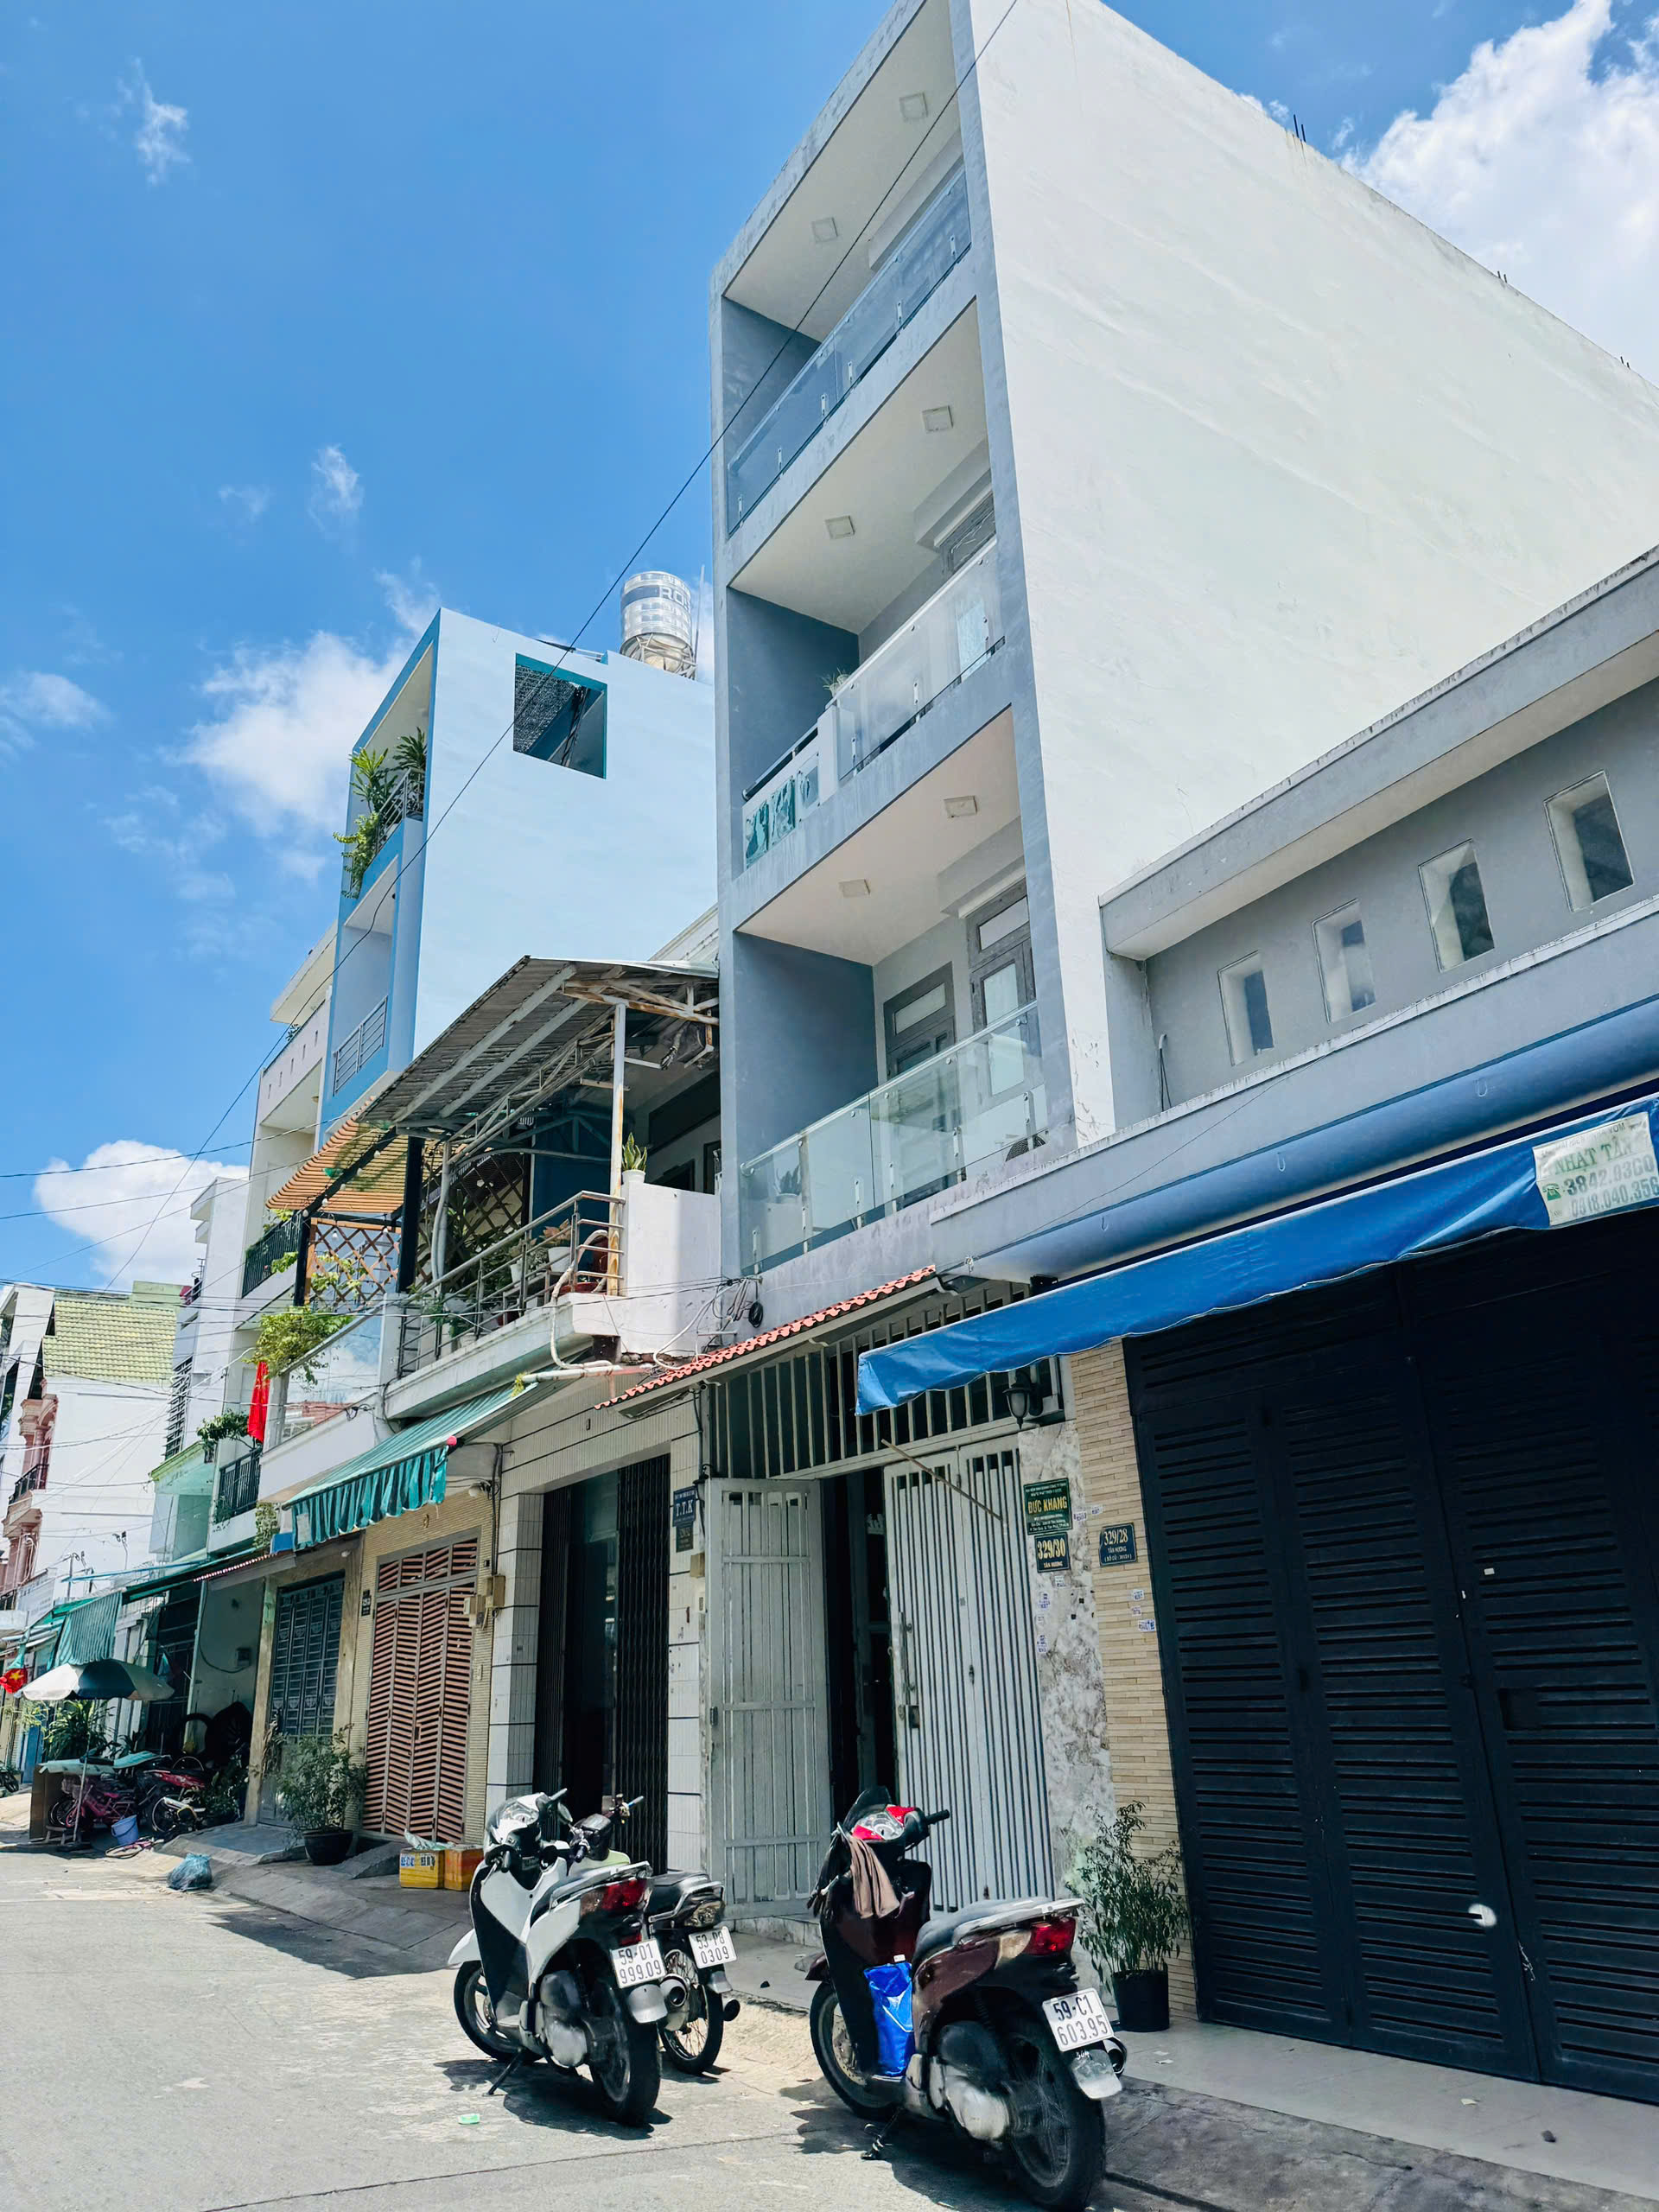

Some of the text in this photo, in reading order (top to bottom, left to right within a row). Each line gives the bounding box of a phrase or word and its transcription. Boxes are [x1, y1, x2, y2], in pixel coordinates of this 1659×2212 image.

[1043, 1496, 1068, 1512] KHANG
[1103, 1529, 1128, 1546] 329/28
[1037, 1538, 1065, 1560] 329/30
[700, 1946, 729, 1964] 0309
[620, 1960, 662, 1984] 999.09
[1057, 2014, 1108, 2046] 603.95
